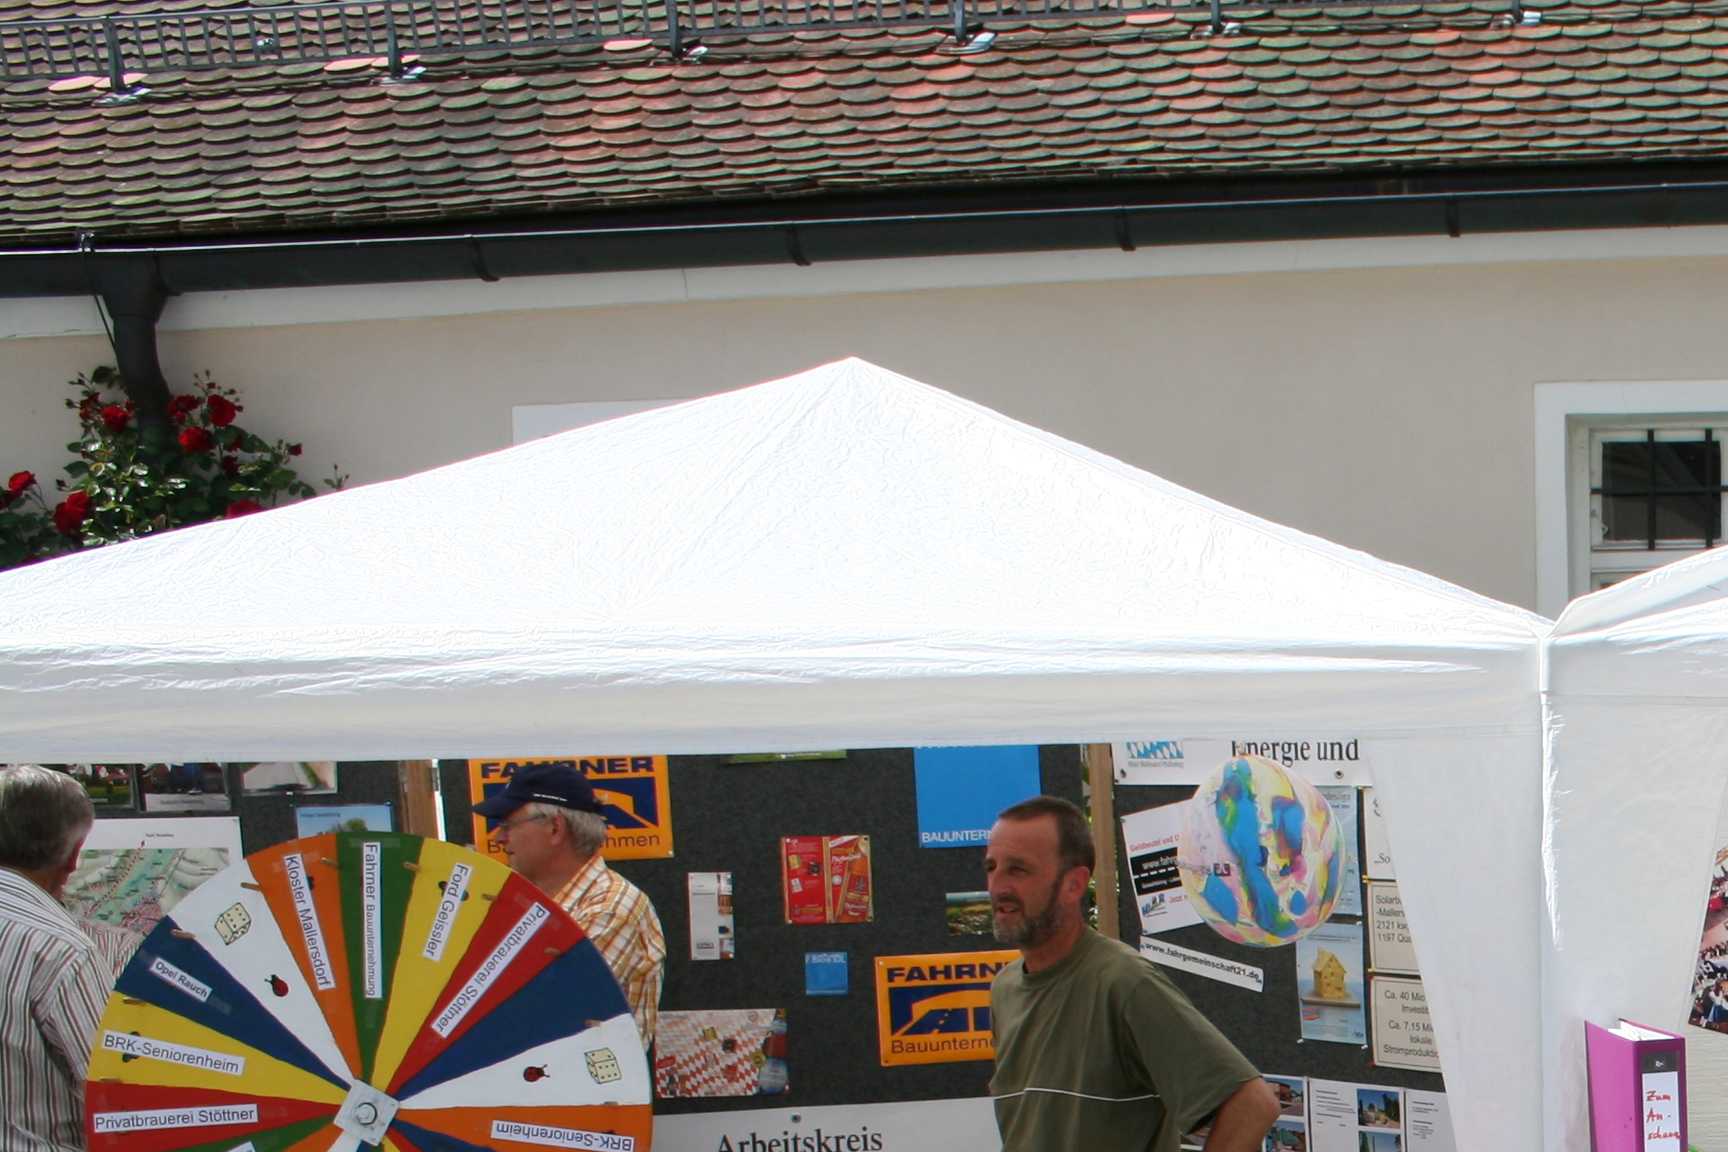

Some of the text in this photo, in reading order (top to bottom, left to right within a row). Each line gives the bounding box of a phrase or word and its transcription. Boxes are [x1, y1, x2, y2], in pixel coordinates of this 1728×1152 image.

[1317, 741, 1359, 761] und
[286, 856, 332, 987] Kloster Mallersdorf
[365, 844, 378, 996] Fahrner Bauunternehmung
[425, 864, 469, 958] Ford Geissler
[155, 960, 208, 997] Opel Rauch
[437, 905, 546, 1033] Privatbrauerei Stöttner
[104, 1034, 240, 1073] BRK-Seniorenheim
[1646, 1090, 1671, 1102] Zum
[95, 1108, 255, 1130] Privatbrauerei Stöttner
[496, 1122, 632, 1152] BRK-Seniorenheim
